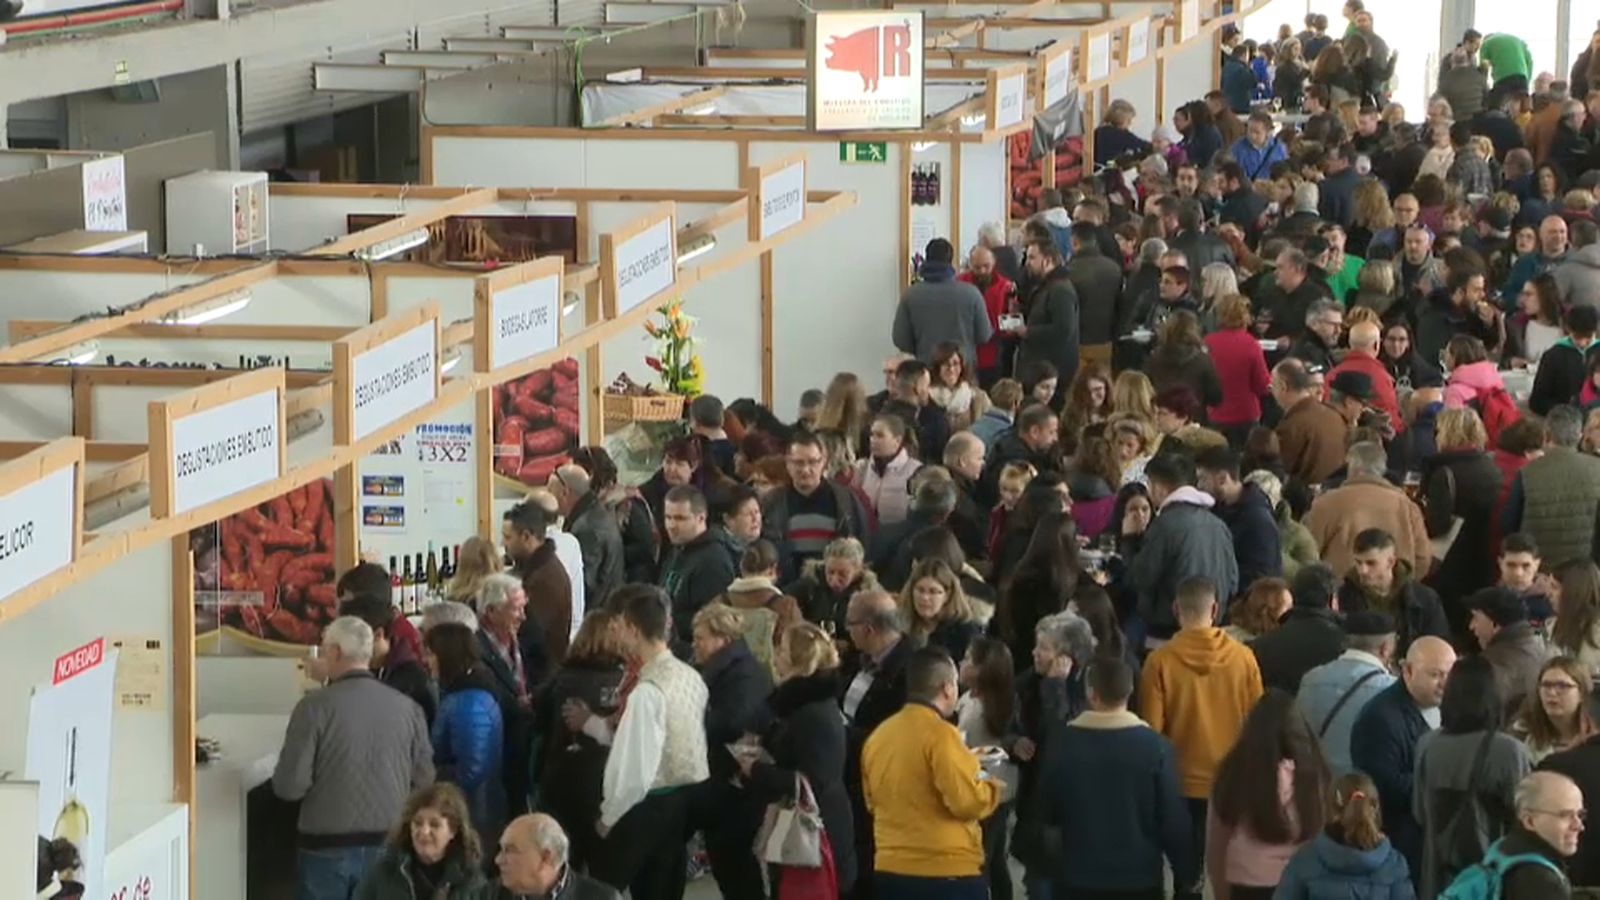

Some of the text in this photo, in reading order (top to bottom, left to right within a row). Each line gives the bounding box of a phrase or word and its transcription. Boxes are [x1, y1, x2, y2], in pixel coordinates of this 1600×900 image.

[355, 353, 431, 408] DEGUSTACIONES EMBUTIDO
[177, 425, 272, 477] DEGUSTACIONES EMBUTIDO
[428, 447, 467, 462] 3X2
[57, 642, 100, 680] NOVEDAD
